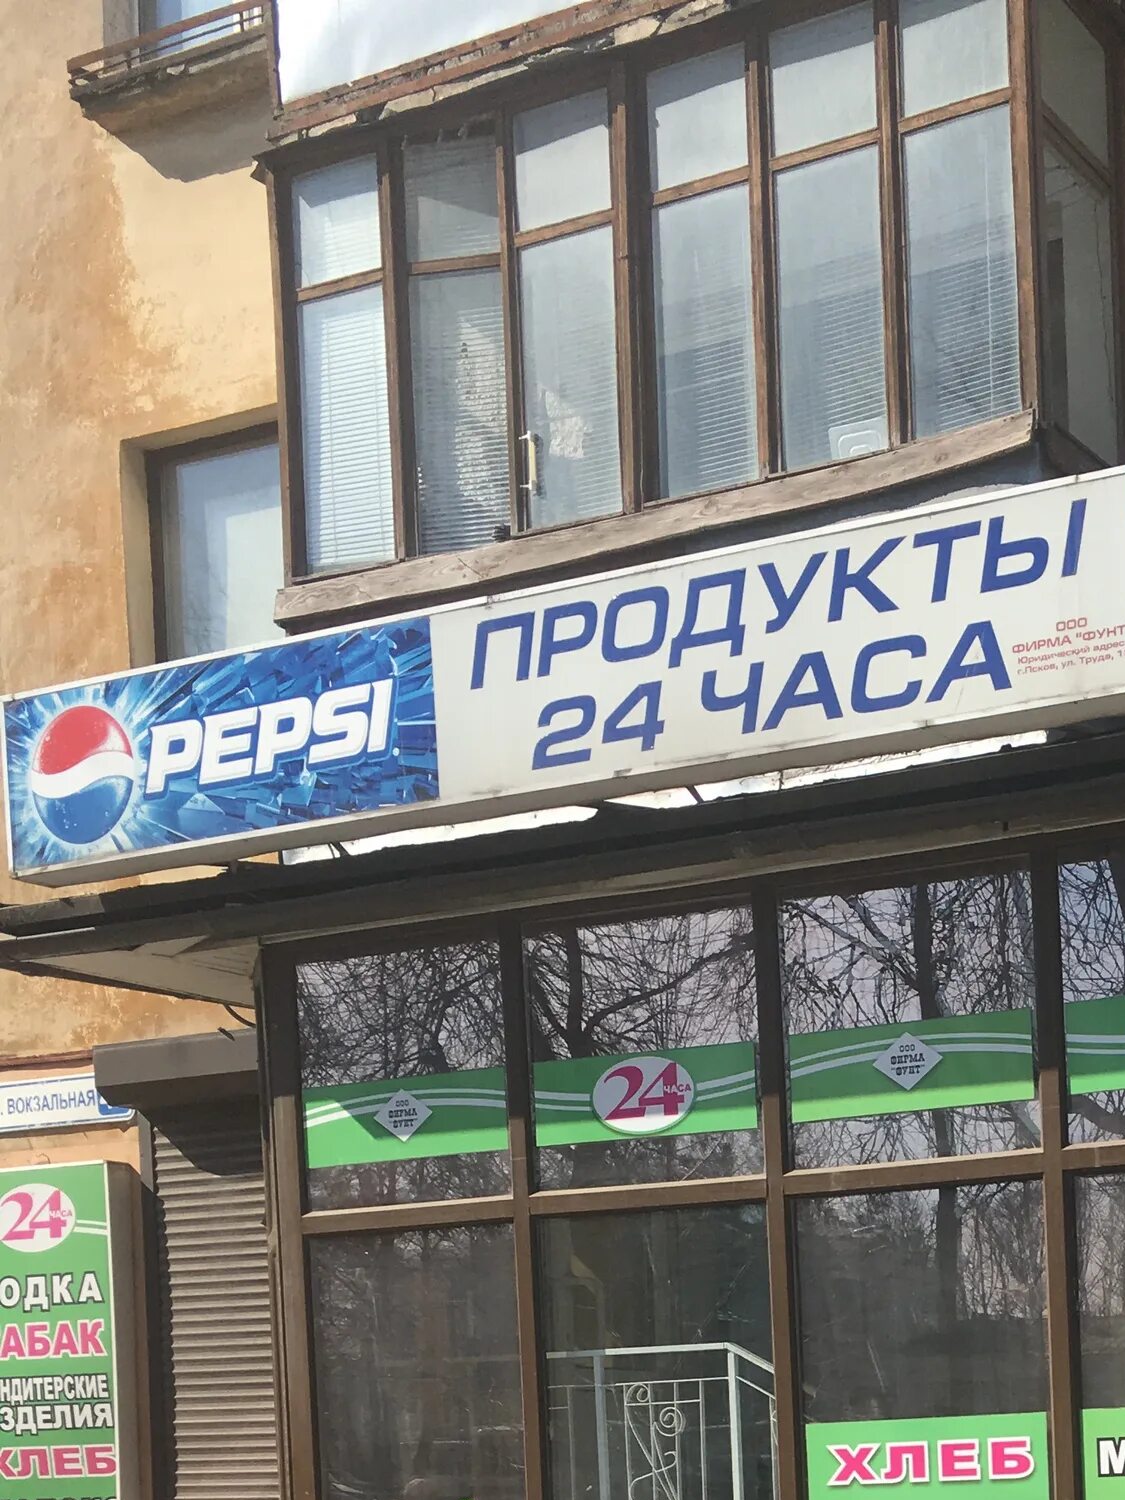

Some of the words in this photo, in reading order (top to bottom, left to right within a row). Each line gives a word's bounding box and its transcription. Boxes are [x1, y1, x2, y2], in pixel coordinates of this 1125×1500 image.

[470, 499, 1087, 690] ПРОДУКТЫ
[1011, 635, 1072, 654] ФИРМА
[1055, 617, 1088, 632] ООО
[1017, 646, 1090, 665] Юридический
[1080, 653, 1114, 666] Труда,
[531, 680, 664, 770] 24
[700, 620, 1012, 735] ЧАСА
[146, 678, 395, 794] PEPSI
[7, 1088, 97, 1116] ВОКЗАЛЬНАЯ
[603, 1062, 685, 1120] 24
[0, 1189, 67, 1241] 24
[826, 1435, 1036, 1488] ХЛЕБ
